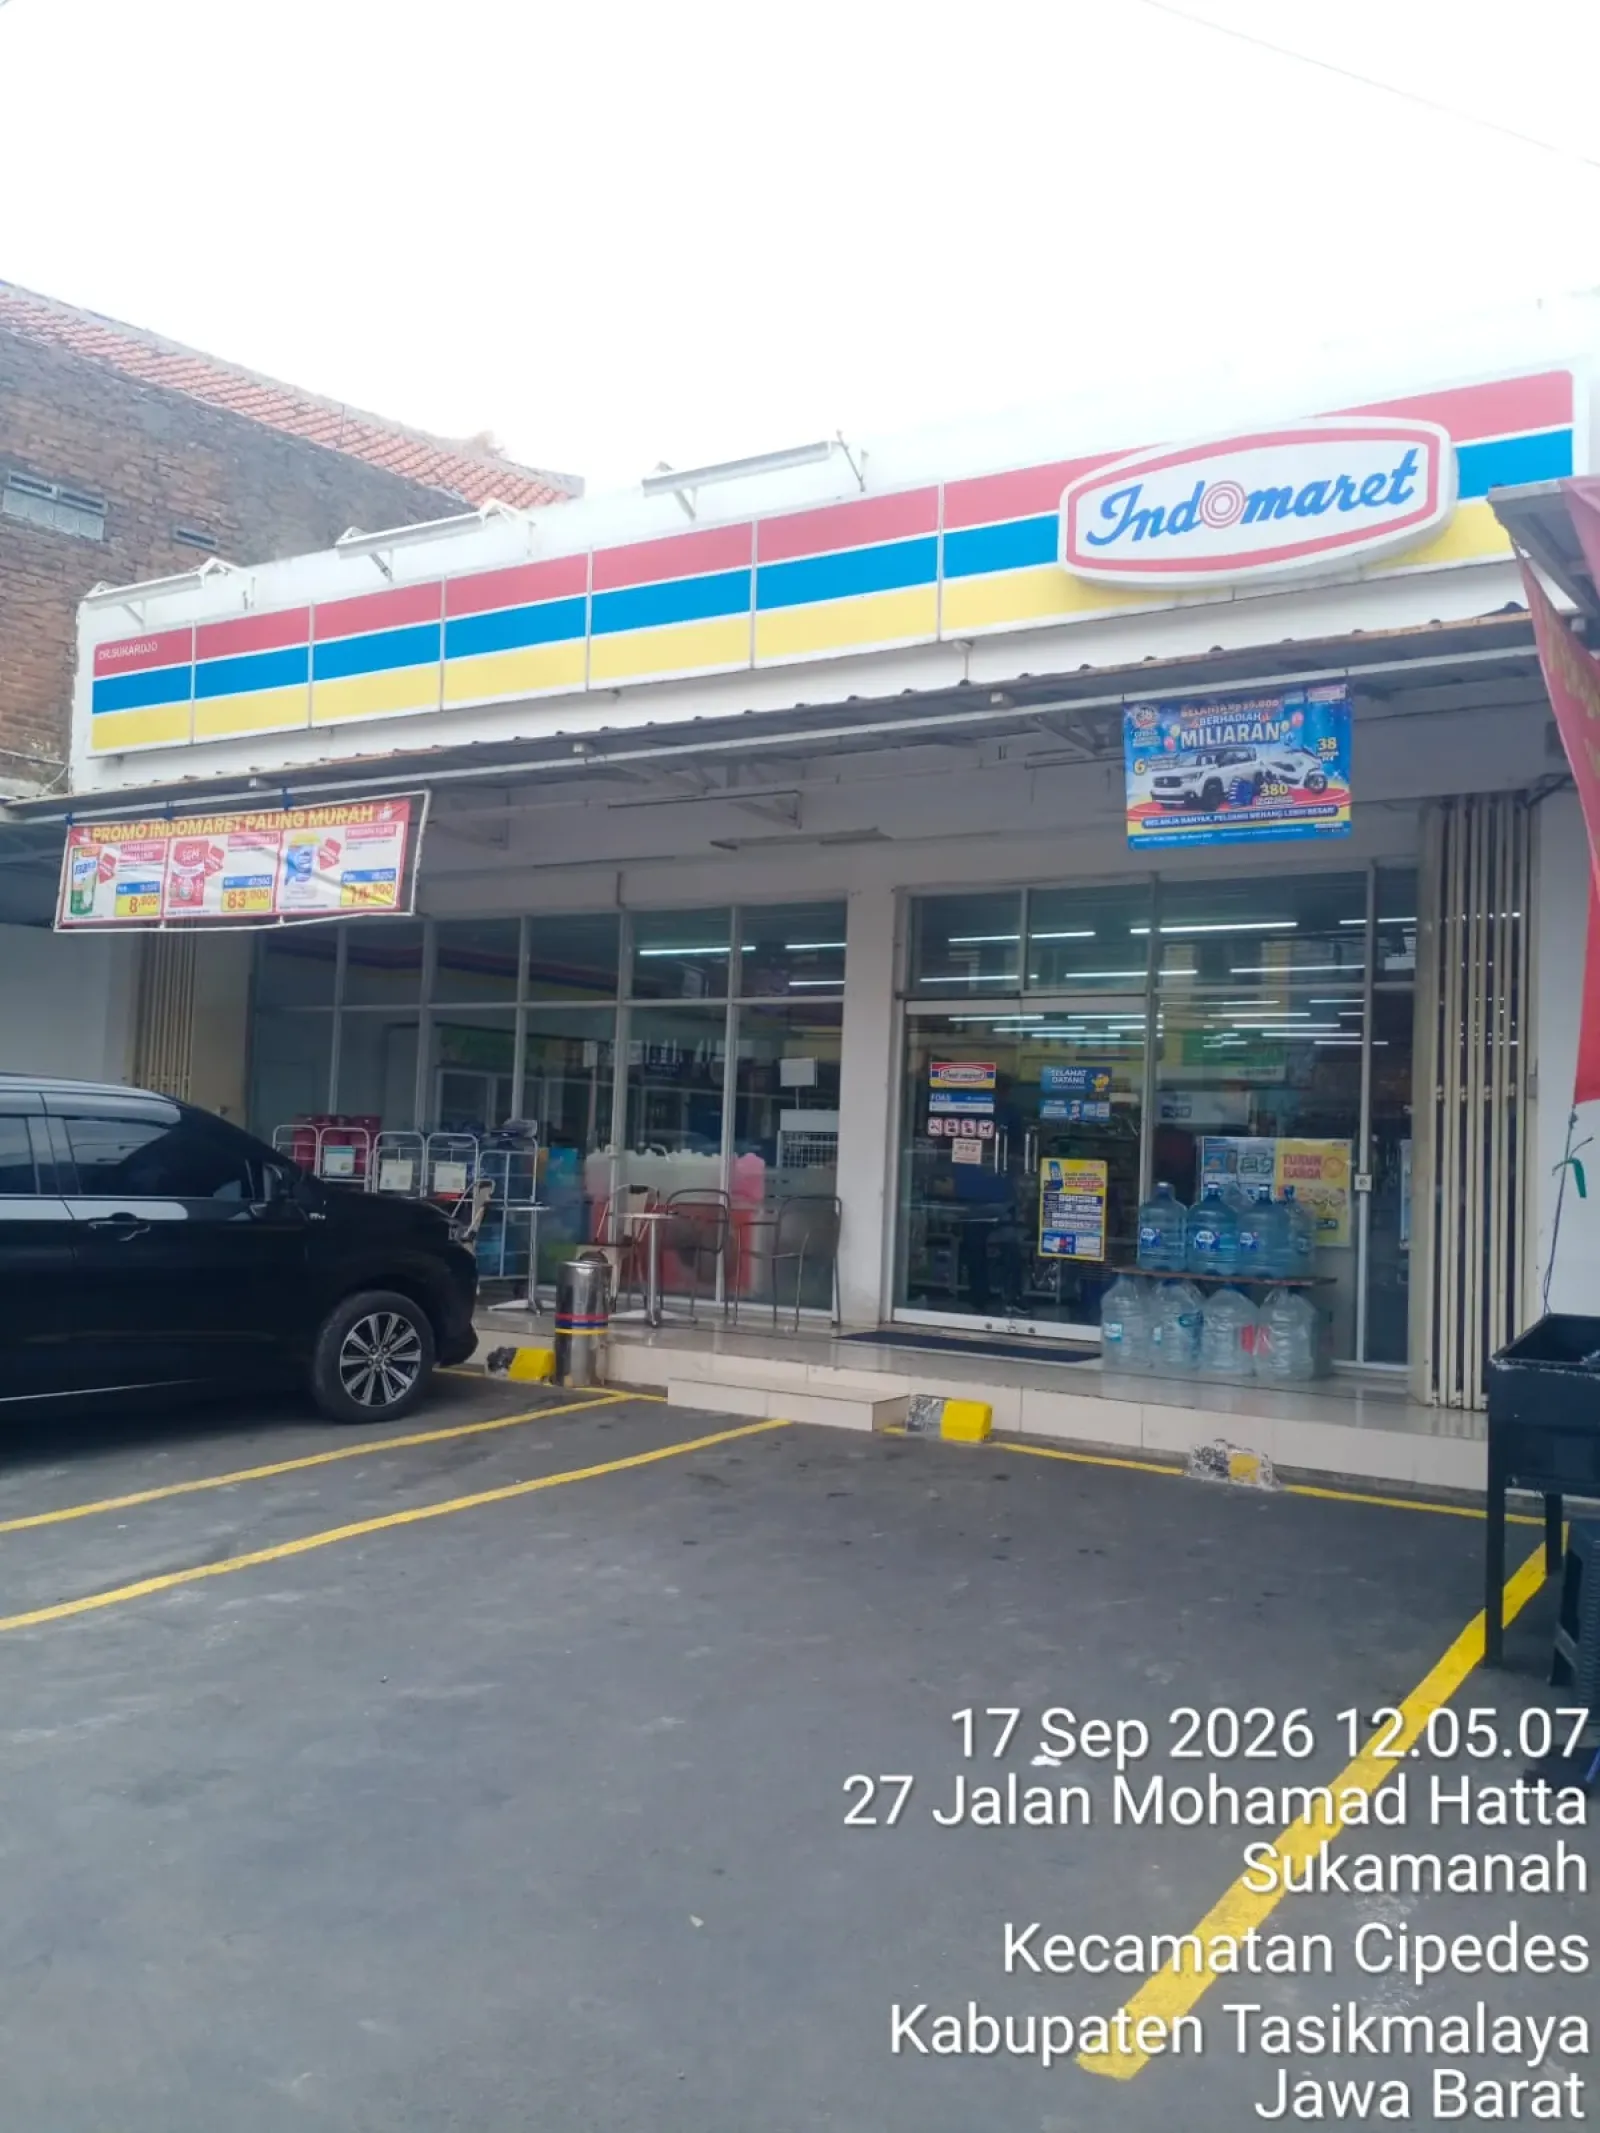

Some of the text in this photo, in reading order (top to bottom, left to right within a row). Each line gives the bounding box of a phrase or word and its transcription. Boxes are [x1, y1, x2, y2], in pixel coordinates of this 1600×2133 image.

[1085, 447, 1419, 546] Indomaret
[1181, 721, 1281, 750] MILIARAN
[1317, 737, 1337, 751] 38
[1134, 759, 1146, 775] 6
[1260, 783, 1289, 797] 380
[91, 804, 374, 843] PROMO INDOMARET PALING MURAH
